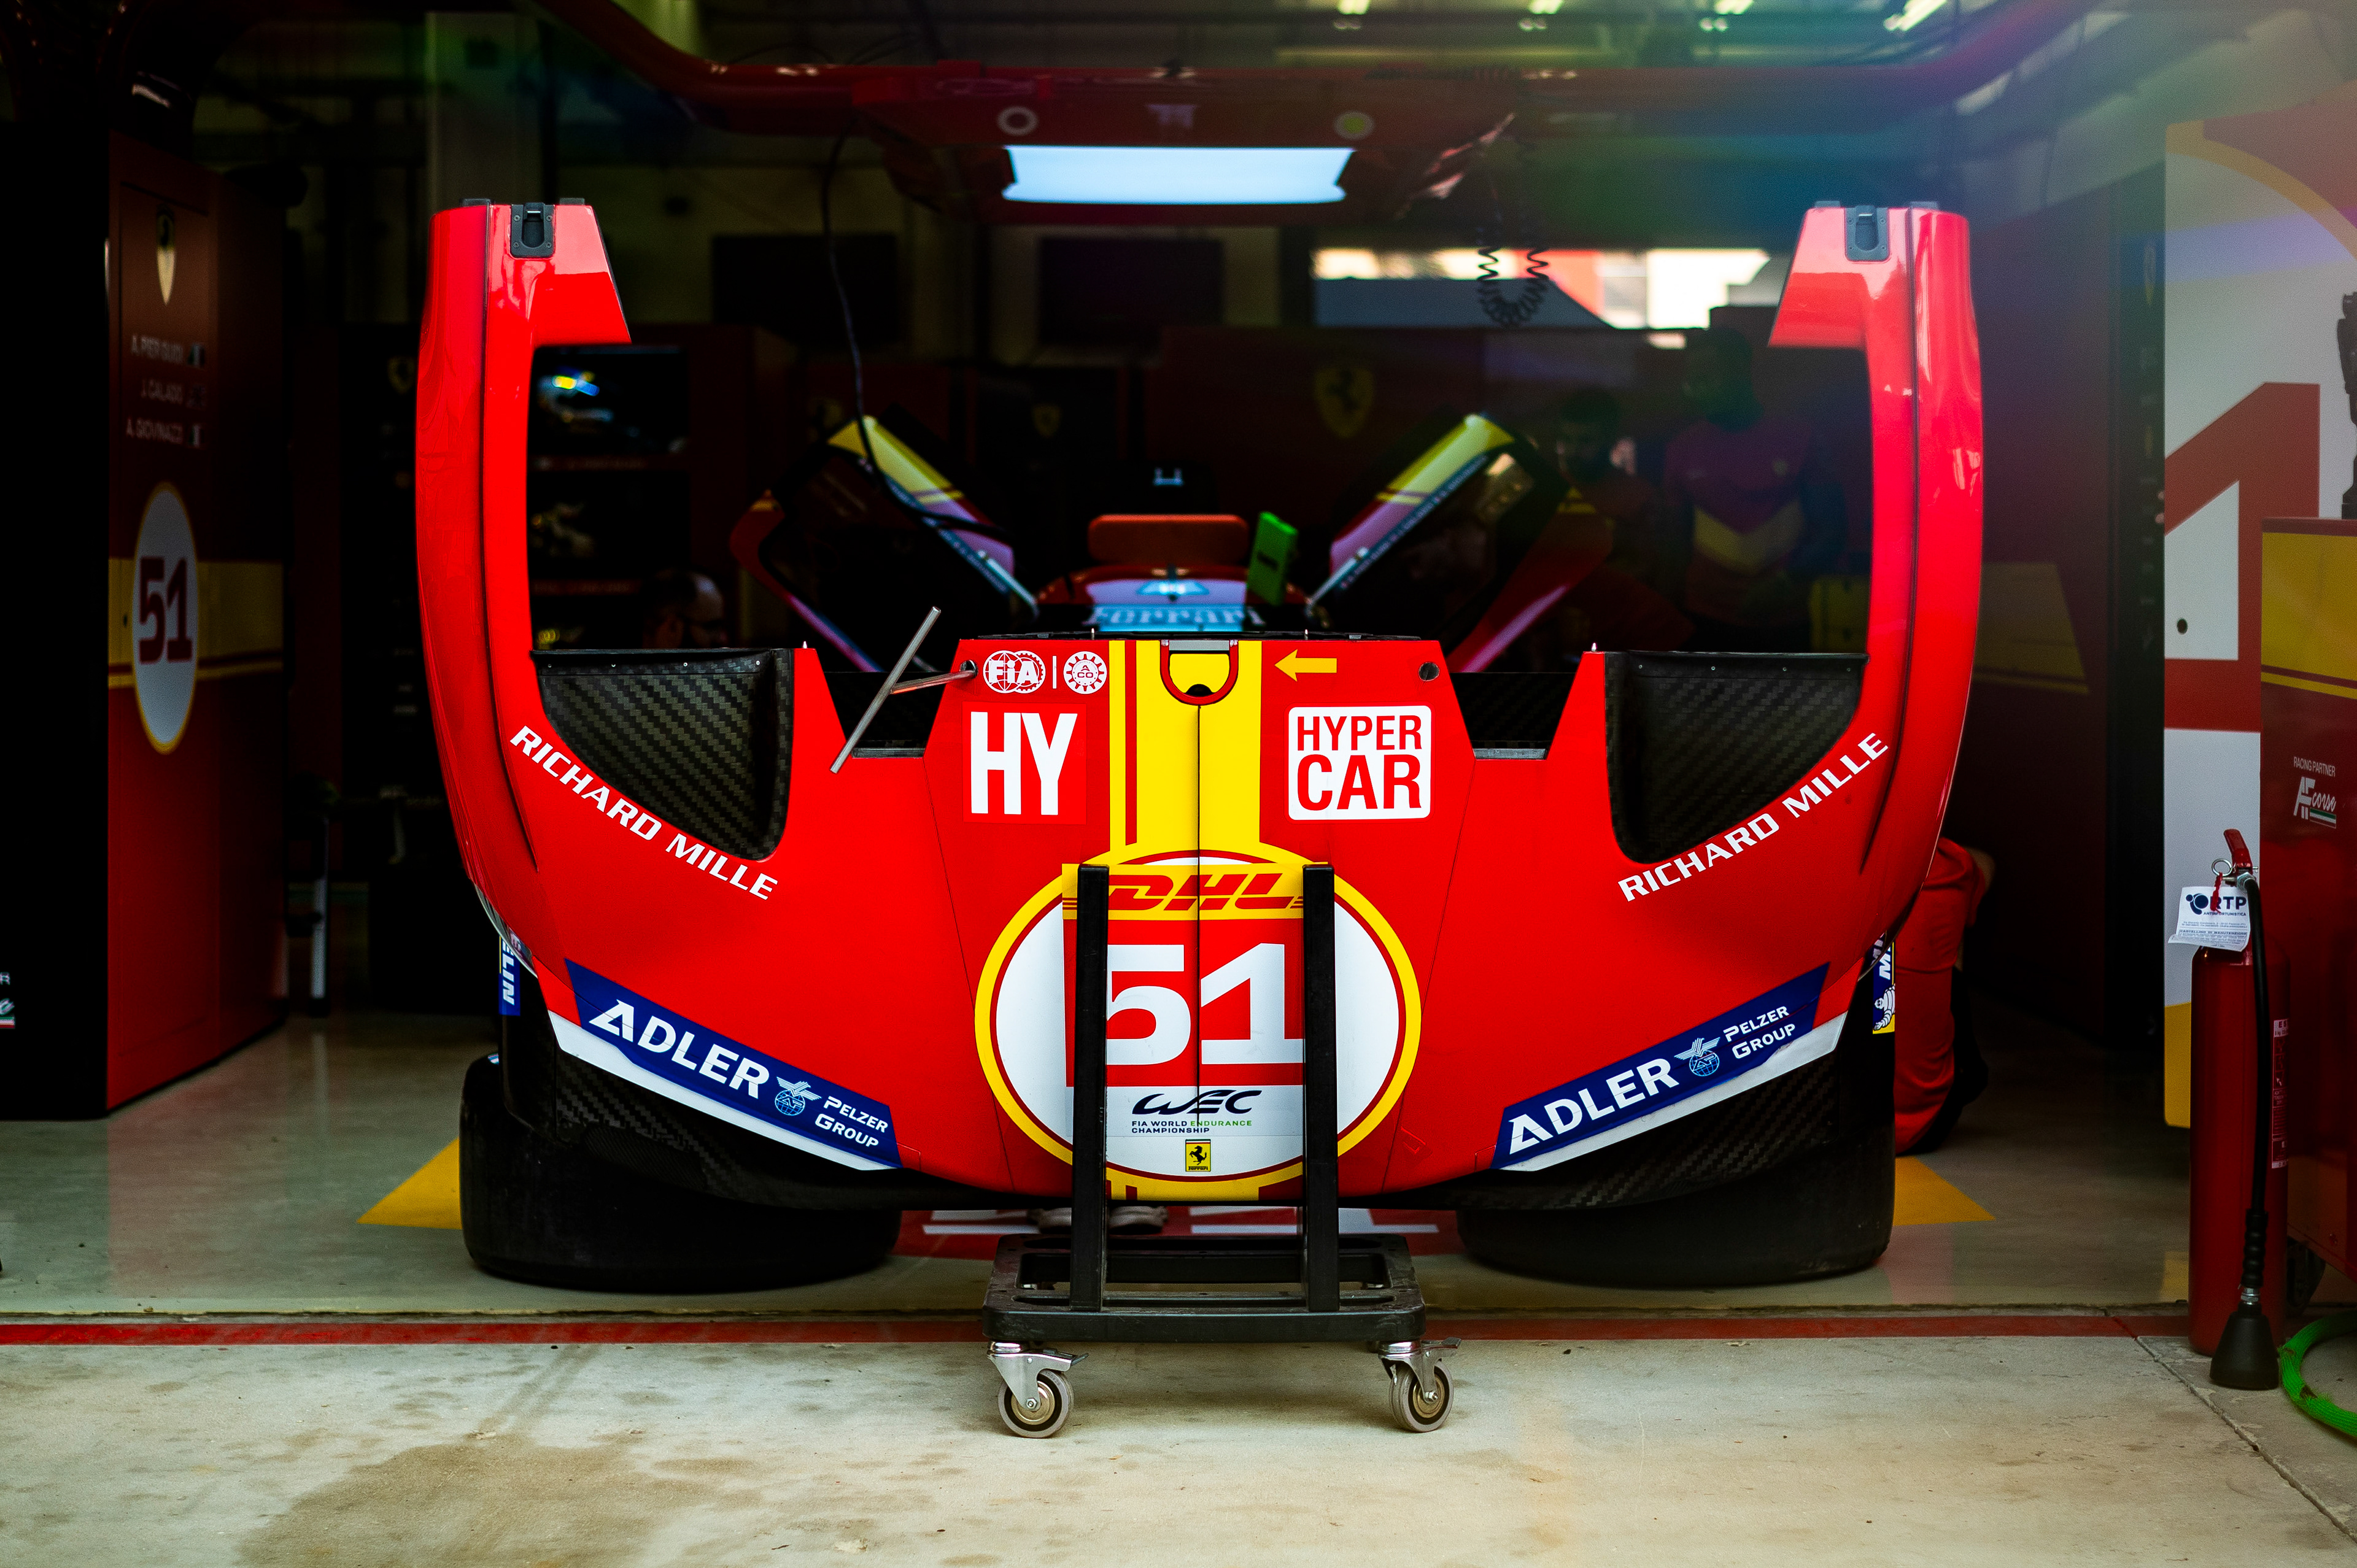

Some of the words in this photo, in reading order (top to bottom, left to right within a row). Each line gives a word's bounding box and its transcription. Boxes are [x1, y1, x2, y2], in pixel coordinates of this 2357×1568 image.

[140, 558, 192, 662] 51
[1297, 715, 1422, 751] HYPER
[971, 711, 1078, 816] HY
[1297, 754, 1422, 811] CAR
[2293, 756, 2312, 772] RACING
[2313, 761, 2336, 778] PARTNER
[509, 725, 662, 841] RICHARD
[665, 833, 778, 900] MILLE
[1617, 813, 1779, 902] RICHARD
[1782, 733, 1889, 818] MILLE
[1107, 873, 1294, 911] DHL
[1106, 943, 1304, 1065] 51
[1723, 1006, 1790, 1041] PELZER
[589, 999, 770, 1099] ADLER
[1732, 1023, 1795, 1059] GROUP
[824, 1095, 889, 1133] PELZER
[1132, 1089, 1263, 1114] WEC
[1509, 1058, 1679, 1155] ADLER
[815, 1113, 879, 1148] GROUP
